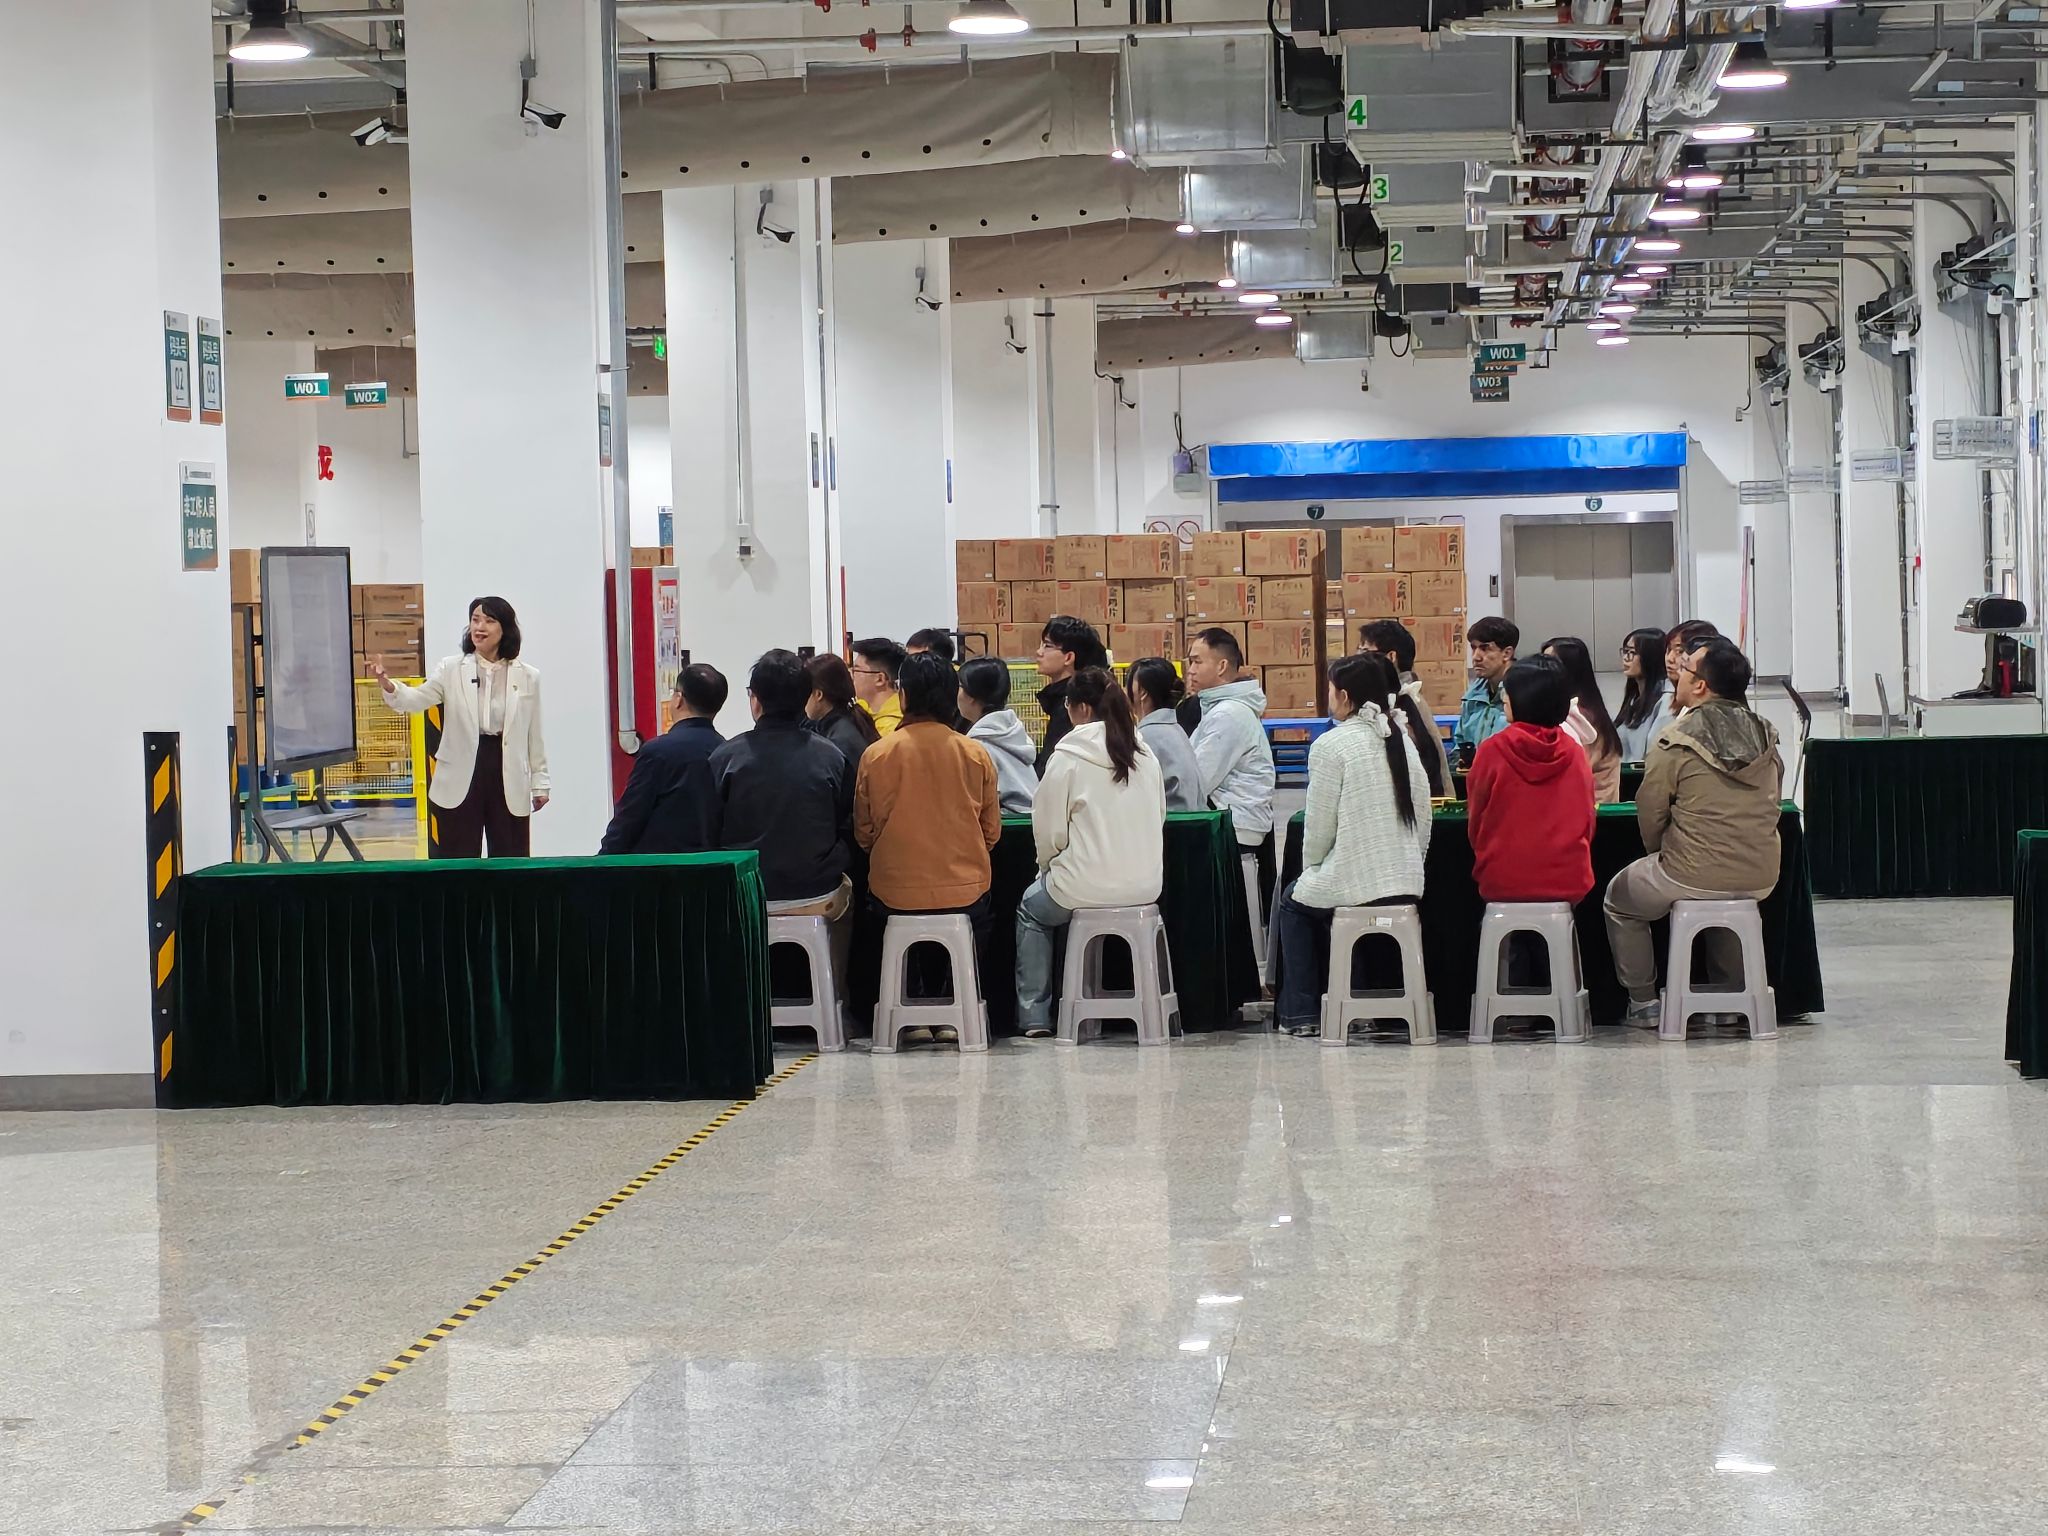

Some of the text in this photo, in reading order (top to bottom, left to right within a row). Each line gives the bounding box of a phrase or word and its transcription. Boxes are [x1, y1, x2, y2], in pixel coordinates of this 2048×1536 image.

[1347, 99, 1366, 126] 4
[1373, 177, 1388, 199] 3
[1390, 243, 1403, 262] 2
[1490, 347, 1518, 360] W01
[174, 367, 184, 390] 02
[206, 370, 216, 394] 03
[1477, 376, 1502, 388] W03
[293, 382, 321, 395] W01
[353, 391, 380, 404] W02
[1590, 499, 1598, 511] 6
[1312, 507, 1319, 519] 7
